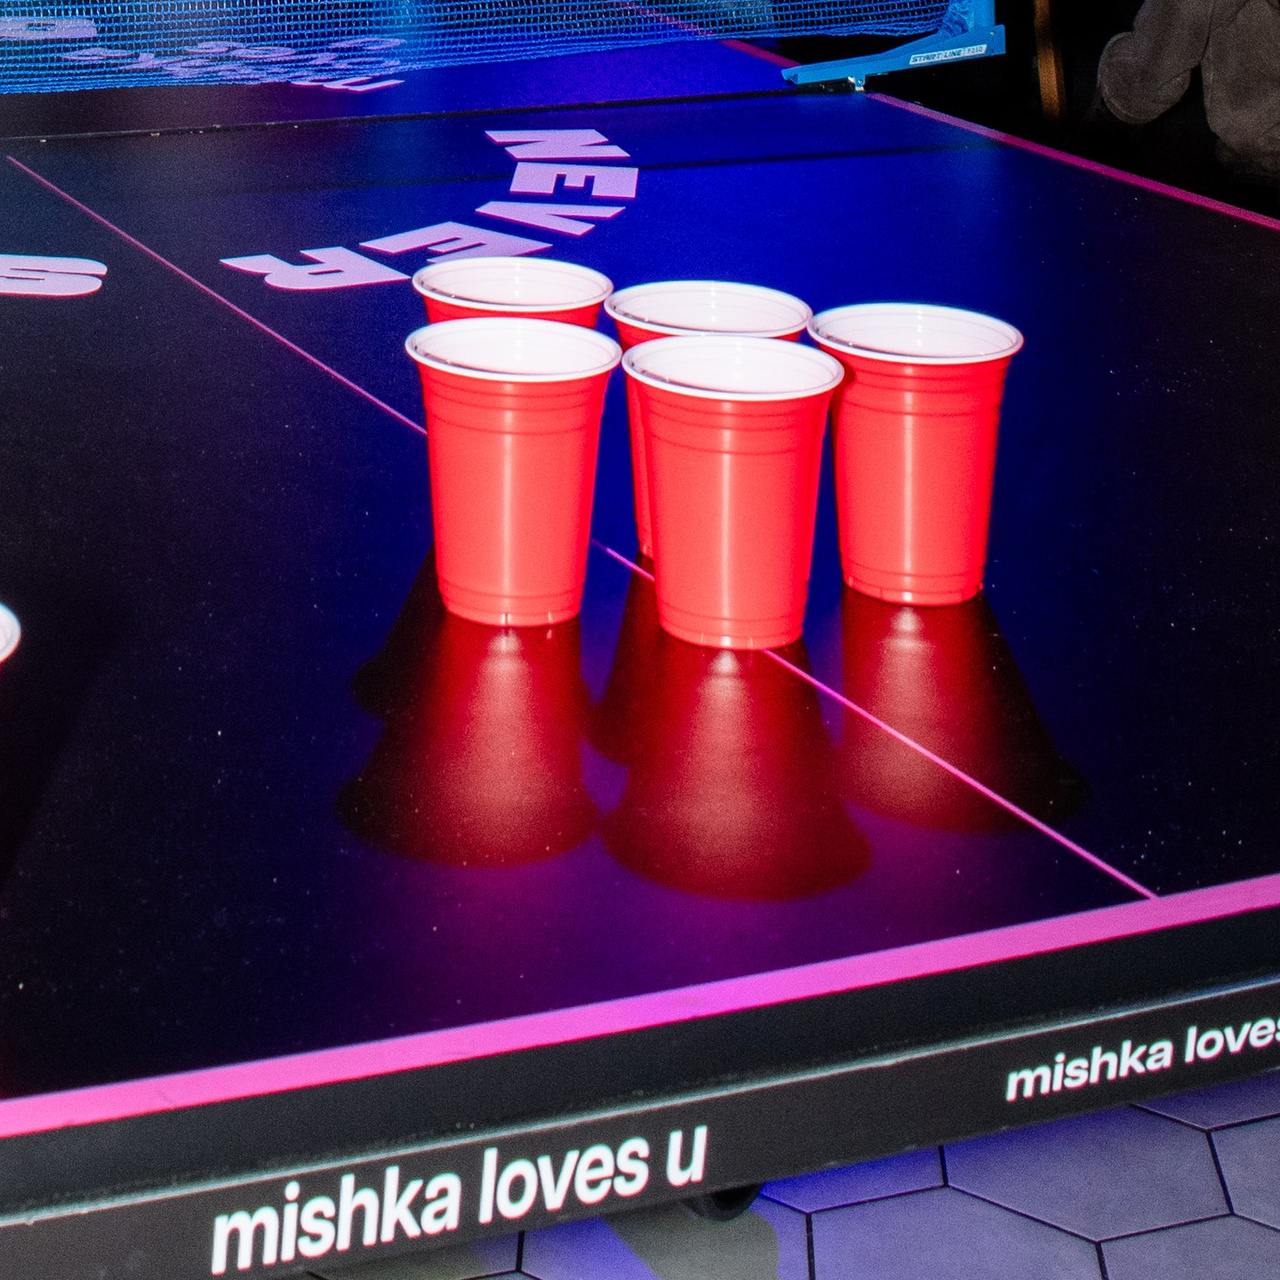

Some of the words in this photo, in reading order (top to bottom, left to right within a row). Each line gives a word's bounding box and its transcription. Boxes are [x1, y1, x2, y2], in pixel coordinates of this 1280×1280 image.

[911, 52, 943, 63] START
[943, 49, 962, 59] LINE
[219, 128, 640, 291] NEVER
[1005, 1039, 1174, 1102] mishka
[1183, 1016, 1280, 1064] love
[211, 1165, 463, 1276] mishka
[478, 1136, 650, 1224] loves
[666, 1124, 709, 1188] u
